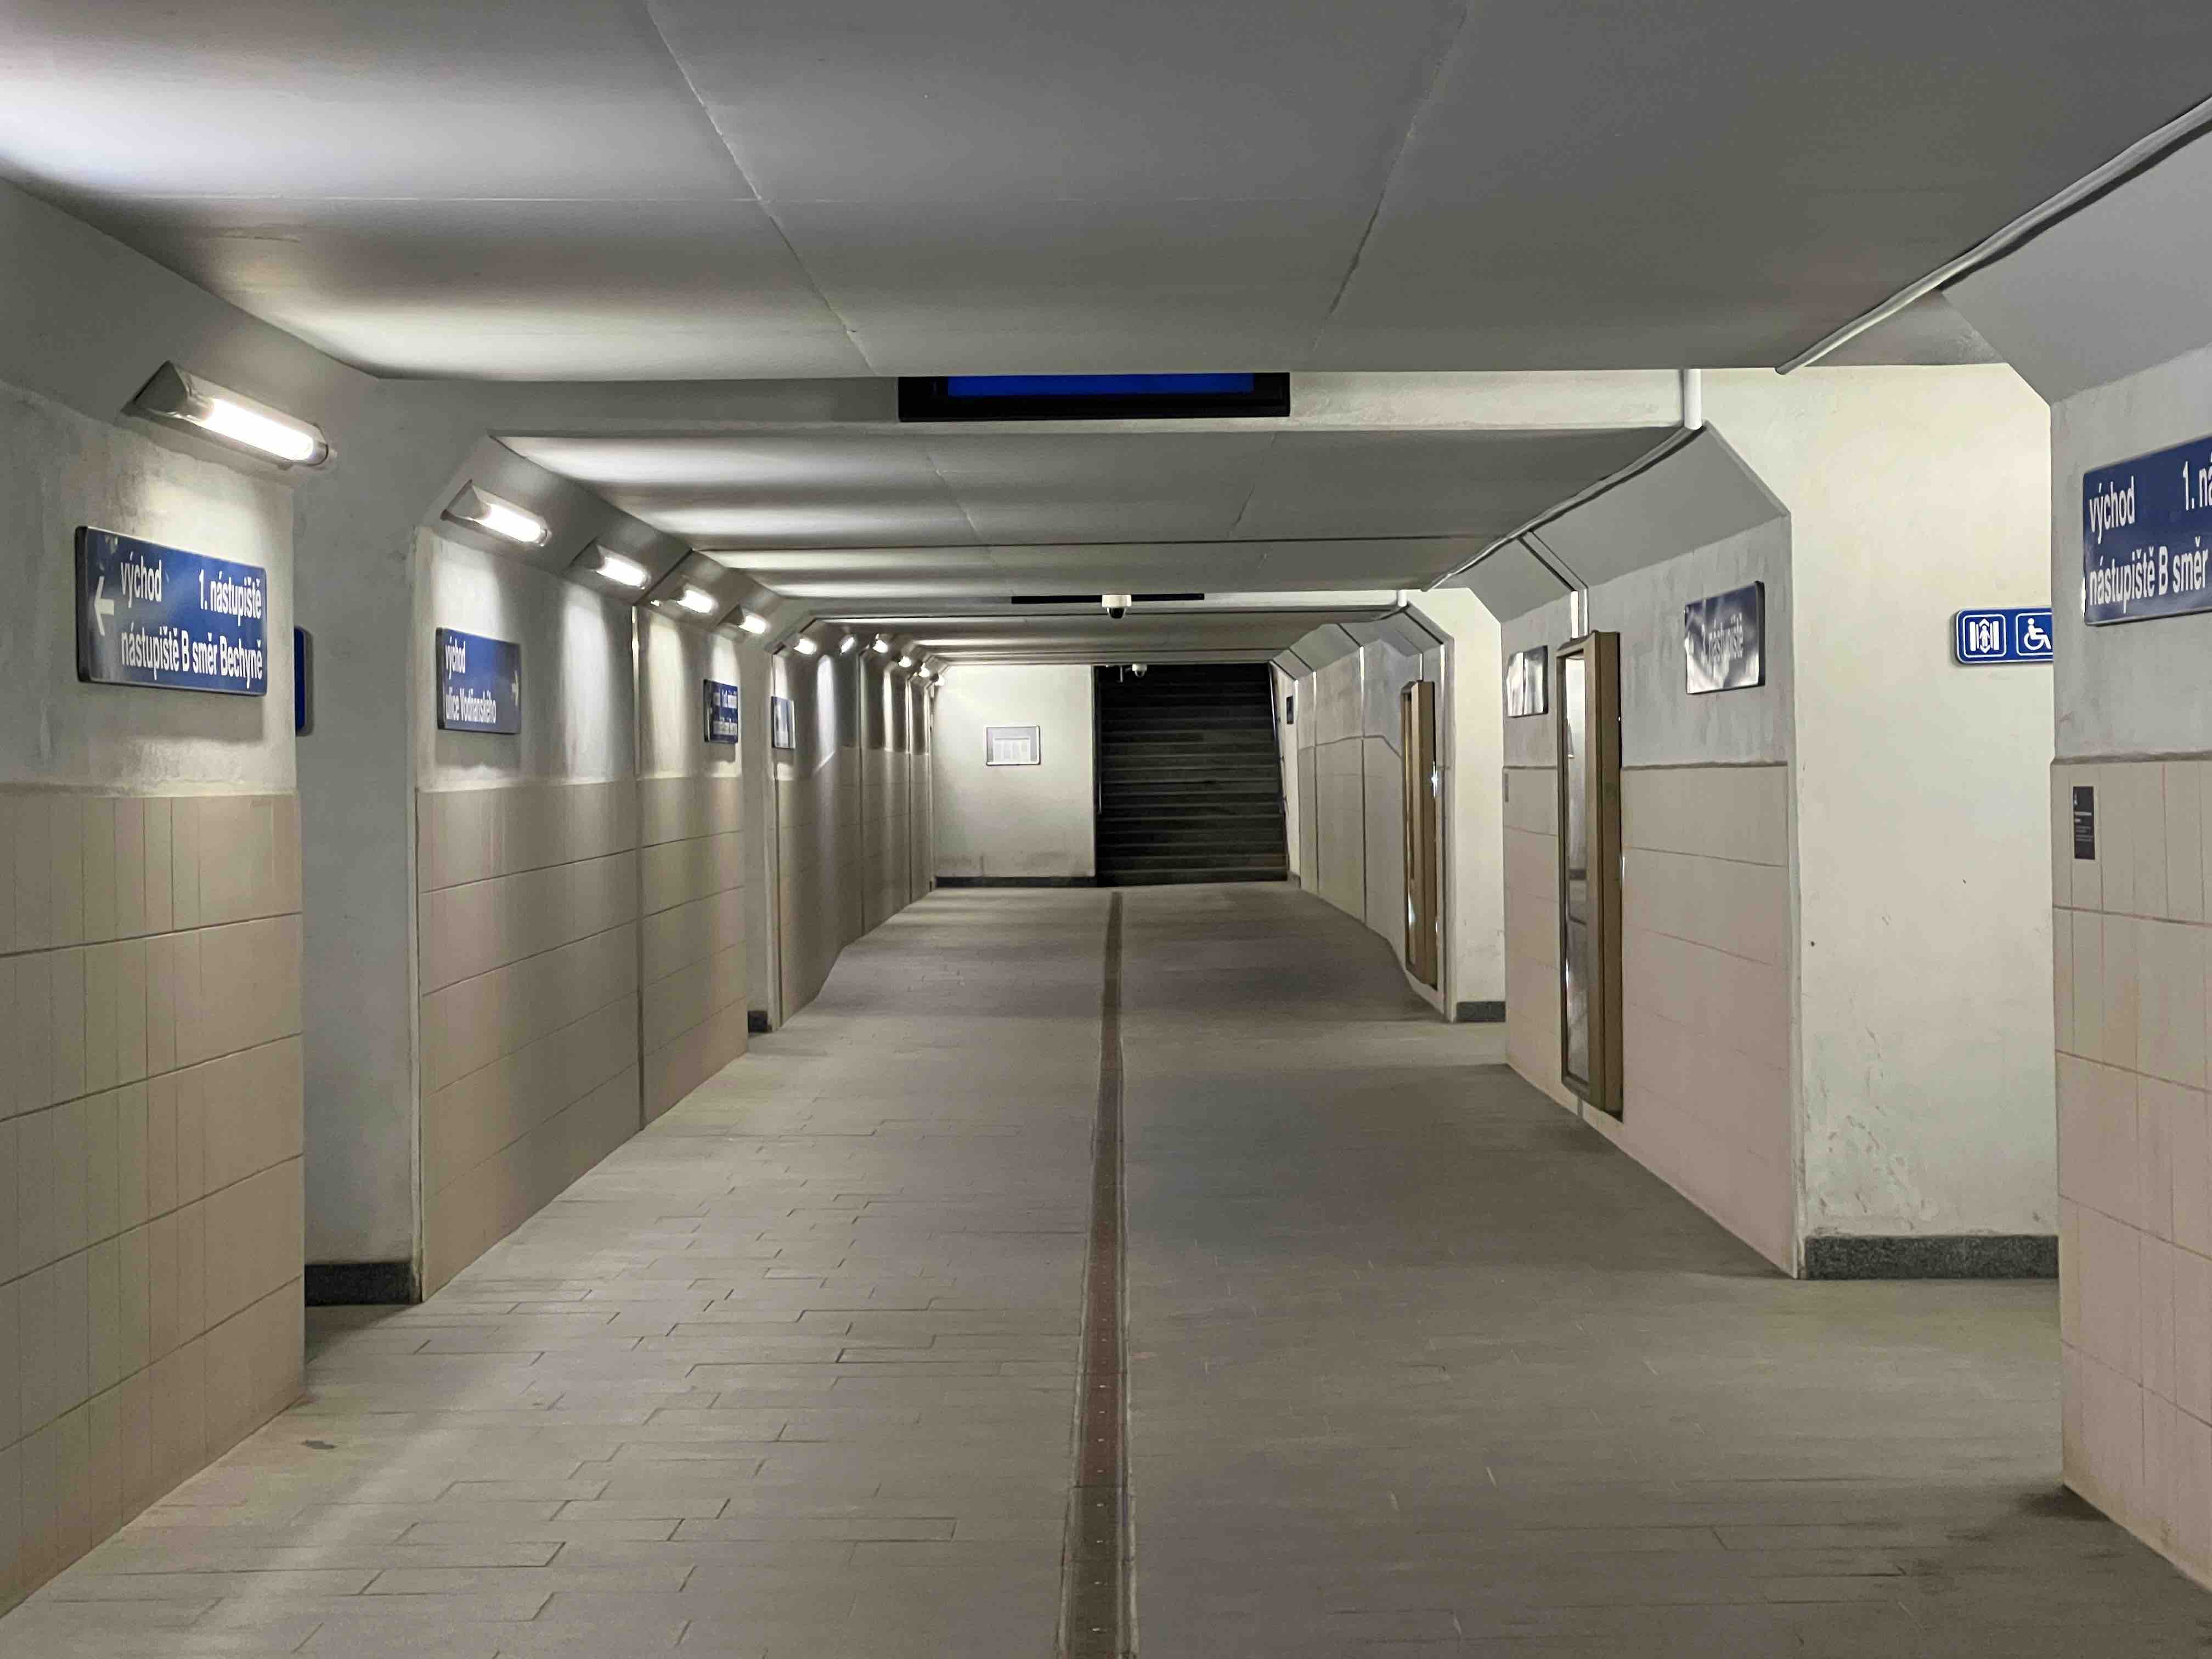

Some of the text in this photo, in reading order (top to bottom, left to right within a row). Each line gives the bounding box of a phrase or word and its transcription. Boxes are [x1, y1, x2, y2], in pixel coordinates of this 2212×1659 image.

[2089, 476, 2135, 544] východ
[2182, 461, 2194, 511] 1.
[121, 551, 162, 607] východ
[199, 569, 262, 626] 1. nástupiště
[2089, 537, 2208, 613] nástupiště B směr
[122, 622, 263, 689] nástupiště B směr Bechyně
[445, 636, 466, 680] východ
